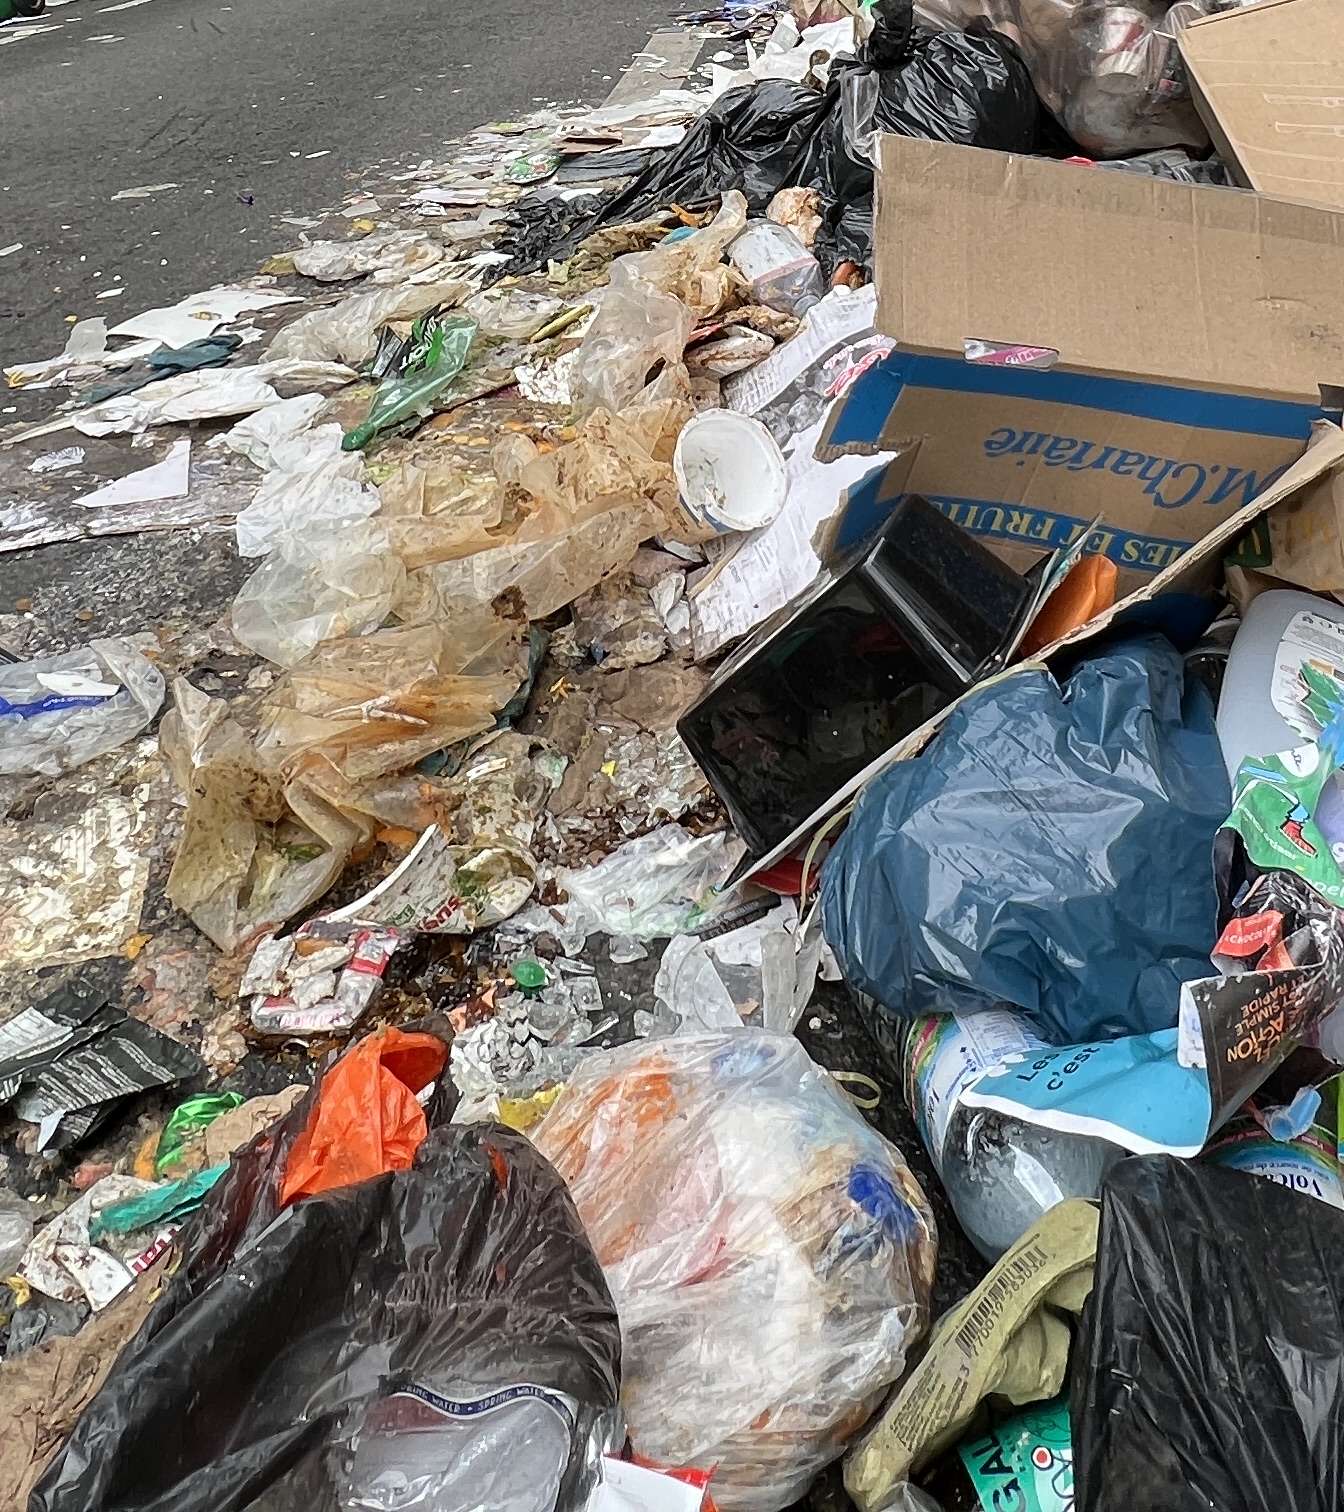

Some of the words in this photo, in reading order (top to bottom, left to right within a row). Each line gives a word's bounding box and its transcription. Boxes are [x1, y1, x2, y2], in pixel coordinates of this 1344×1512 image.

[1240, 982, 1290, 1018] RAPIDE
[1226, 1012, 1285, 1063] ACTION
[1234, 1003, 1281, 1037] SIMPLE
[431, 1397, 462, 1415] WATER
[477, 1393, 514, 1412] SPRING
[515, 1387, 546, 1400] WATER
